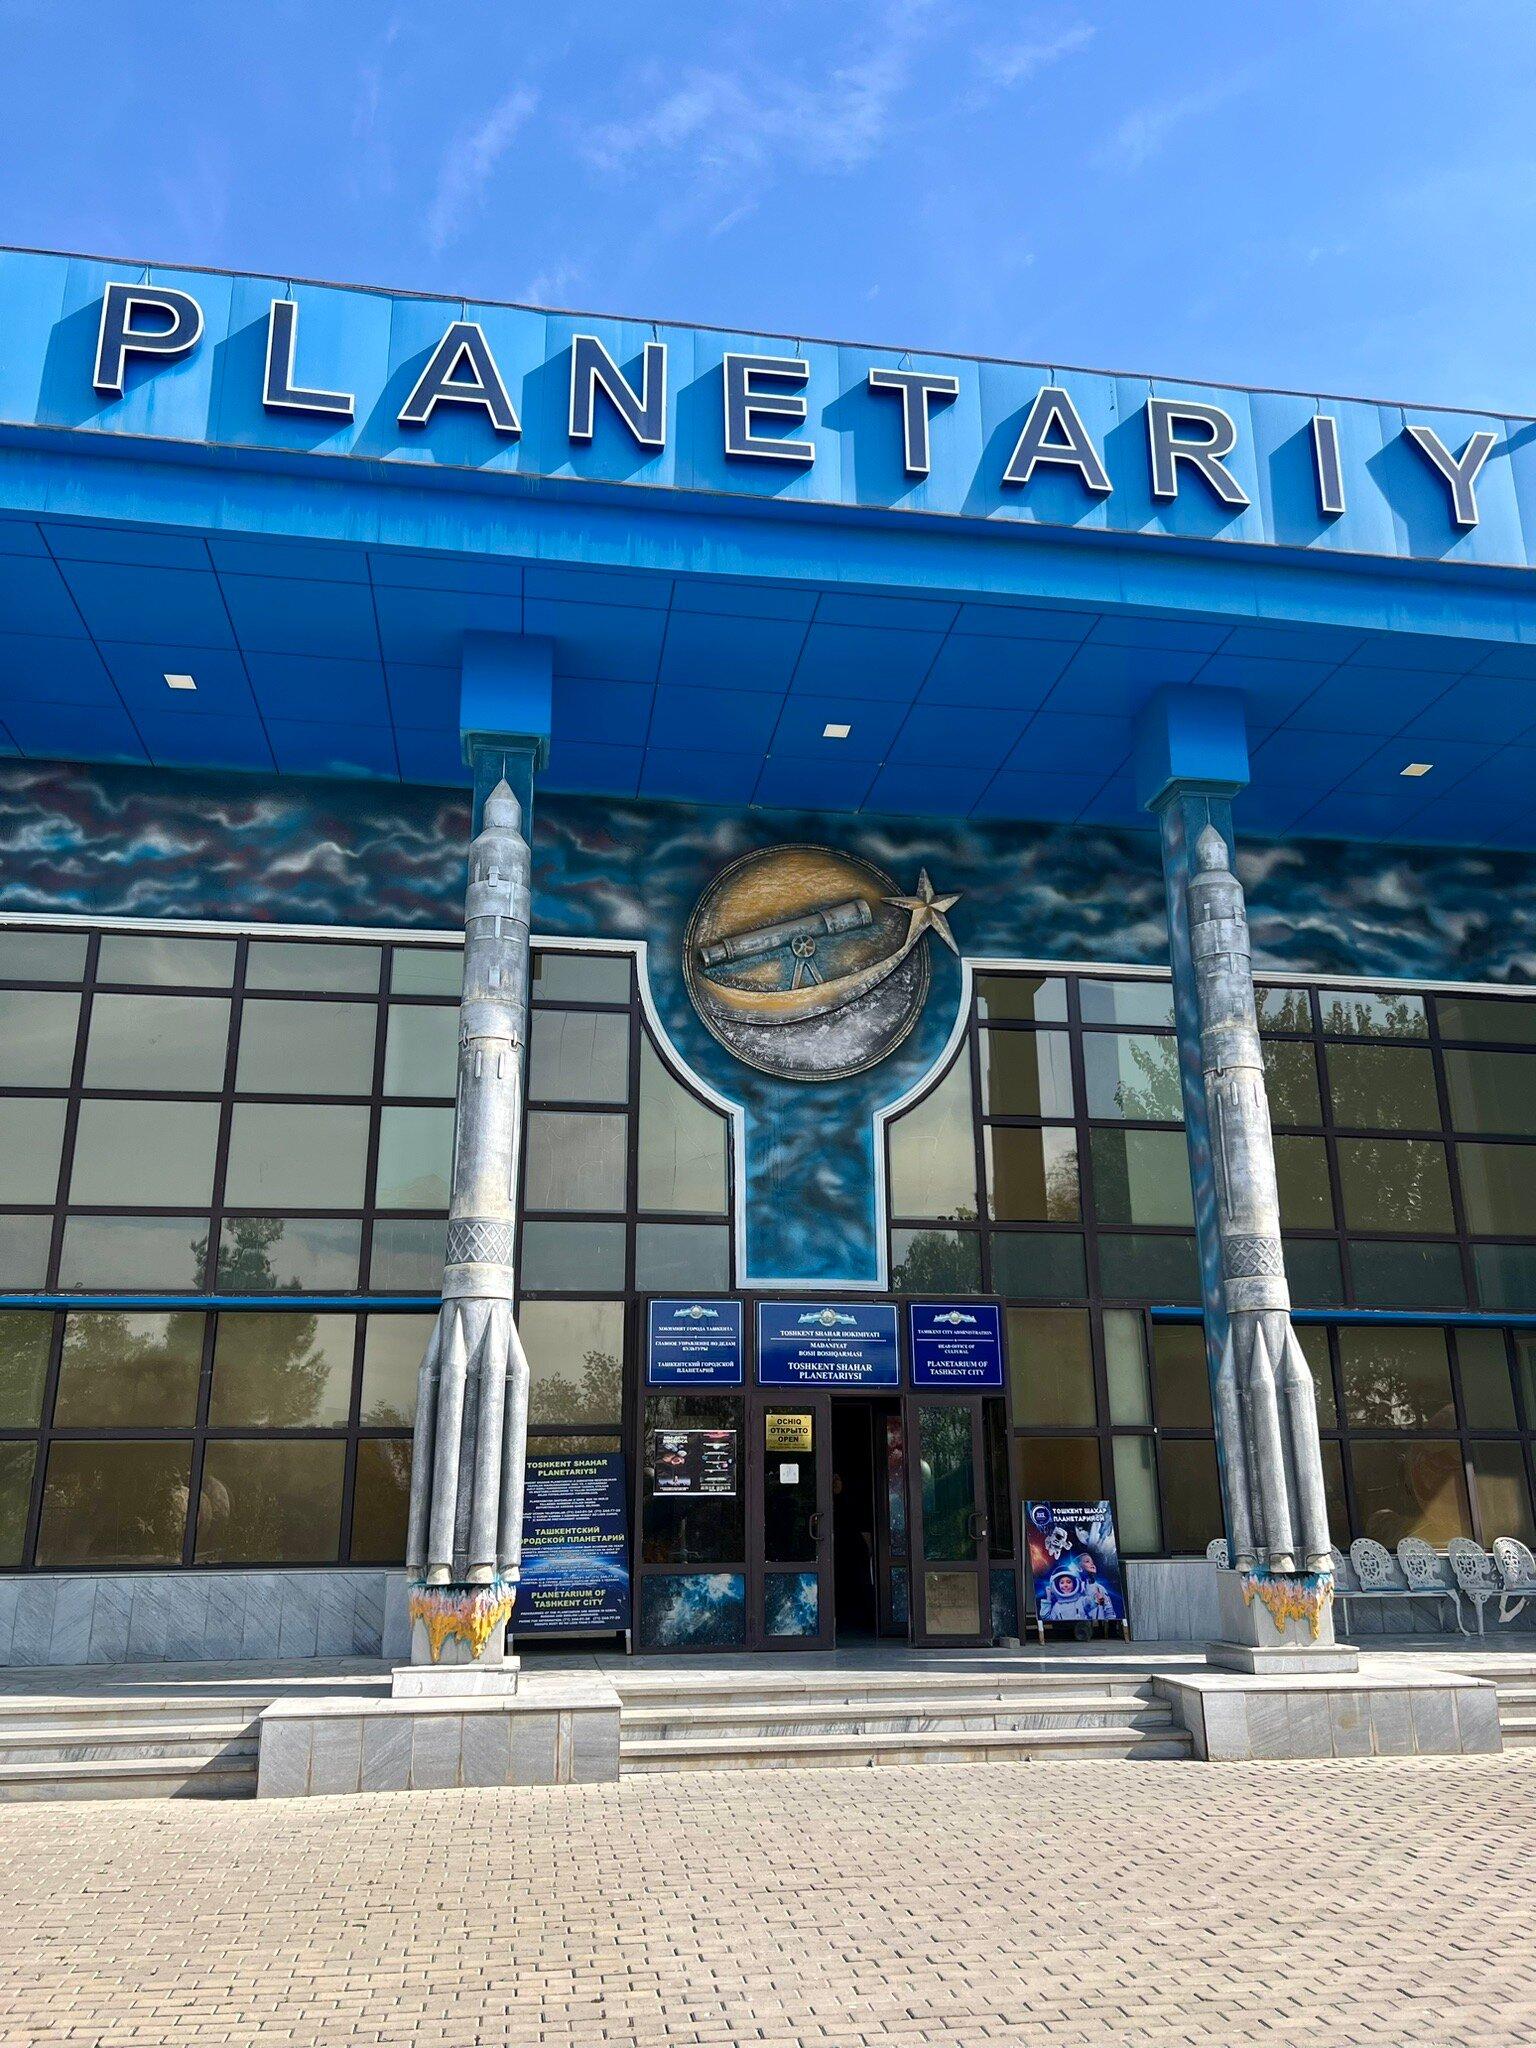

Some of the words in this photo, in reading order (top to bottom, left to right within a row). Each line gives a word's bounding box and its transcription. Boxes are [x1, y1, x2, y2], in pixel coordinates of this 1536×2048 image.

[92, 281, 1498, 528] PLANETARIY
[817, 1350, 862, 1358] BOSHQARMASI
[788, 1362, 836, 1371] TOSHKENT
[836, 1363, 873, 1372] SHAHAR
[927, 1360, 977, 1368] PLANETARIUM
[978, 1360, 988, 1368] OF
[799, 1371, 862, 1380] PLANETARIYSI
[930, 1368, 966, 1376] TASHKENT
[967, 1368, 985, 1376] CITY
[526, 1460, 571, 1469] TOSHKENT
[573, 1459, 608, 1467] SHAHAR
[537, 1468, 597, 1477] PLANETARIYSI
[534, 1526, 600, 1536] ТАШКЕНТСКИЙ
[567, 1534, 625, 1543] ПЛАНЕТАРИЙ
[531, 1590, 593, 1599] PLANETARIUM
[534, 1600, 580, 1608] TASHKENT
